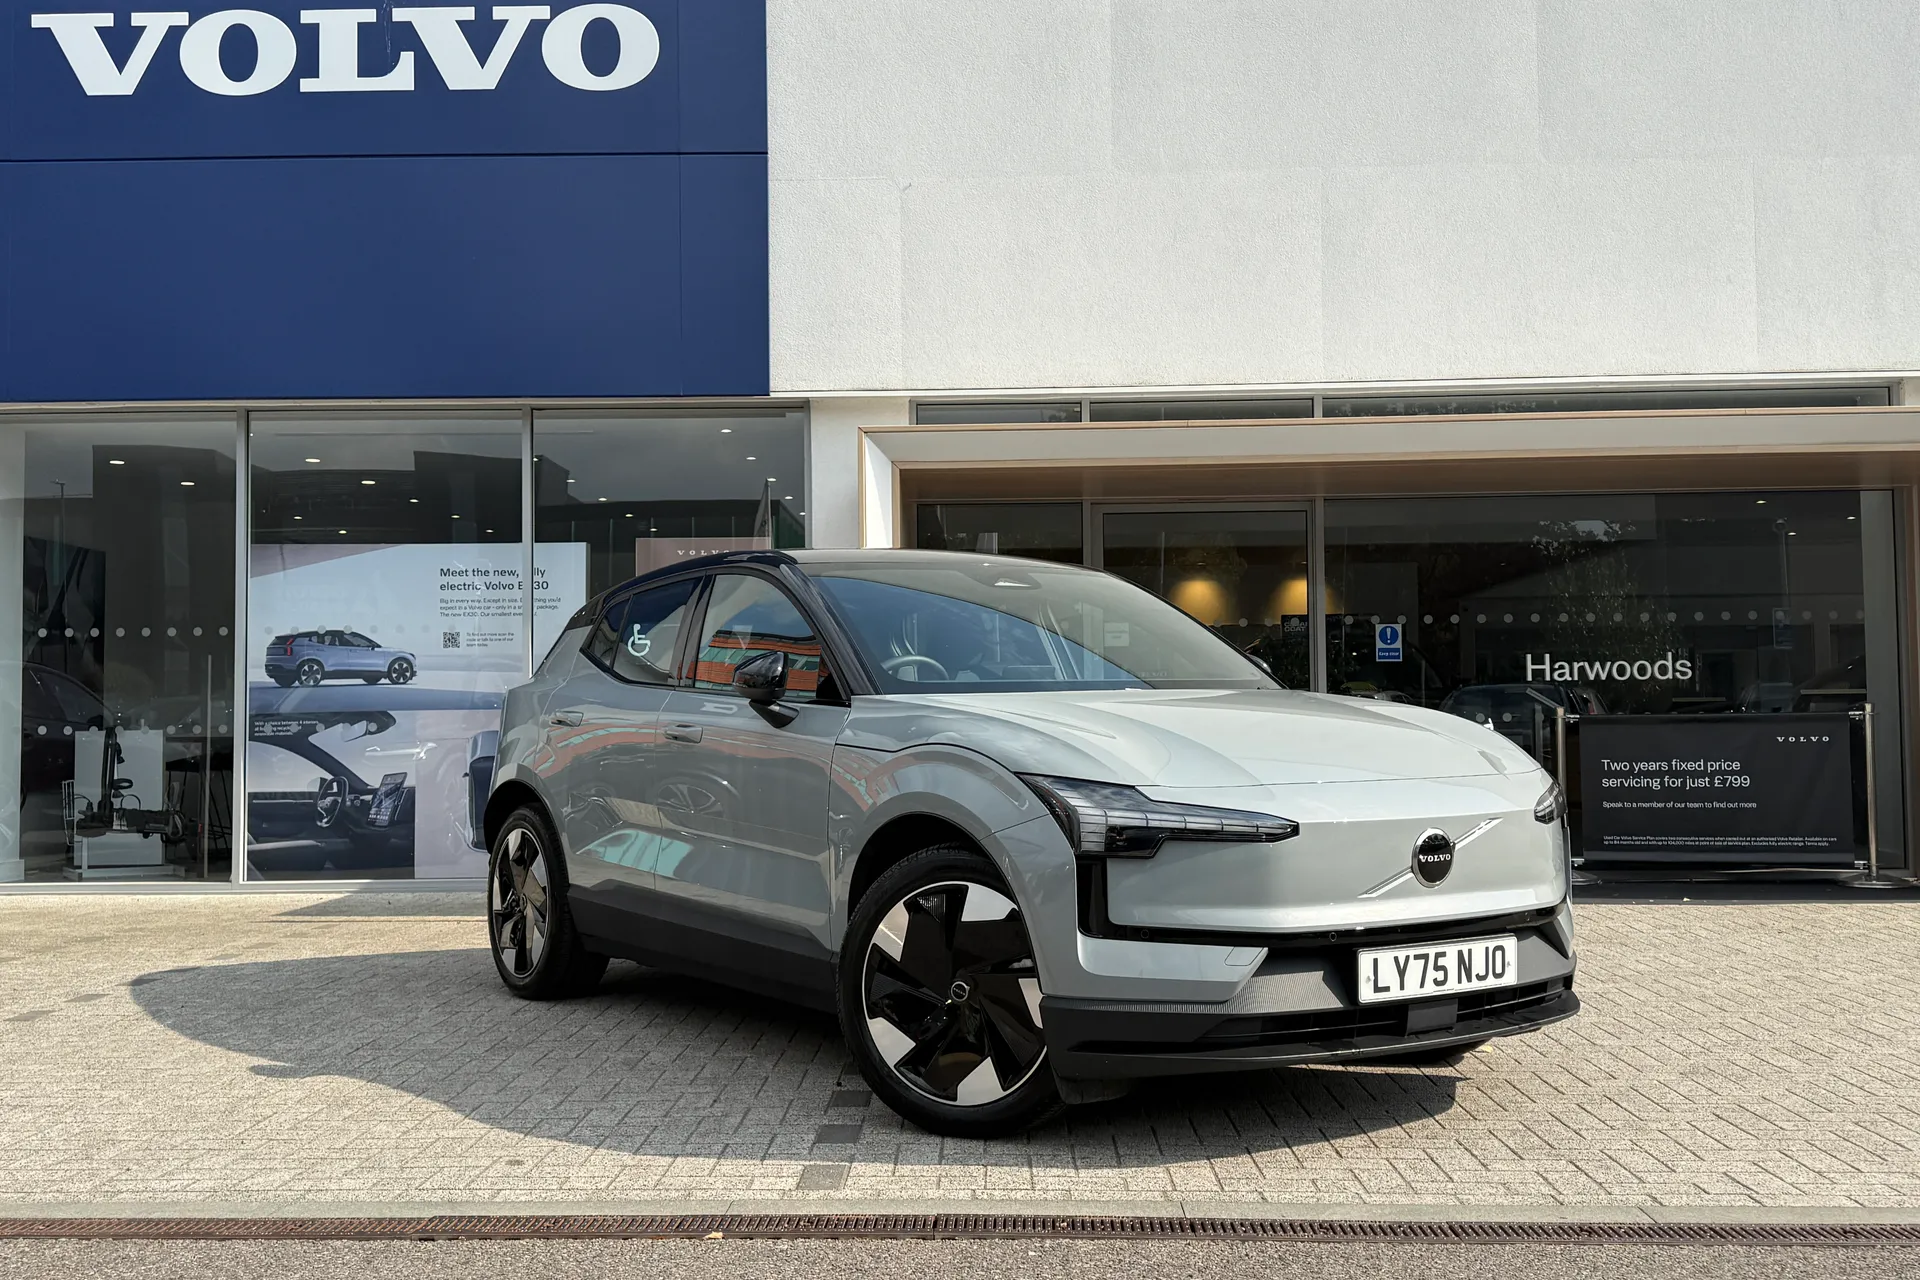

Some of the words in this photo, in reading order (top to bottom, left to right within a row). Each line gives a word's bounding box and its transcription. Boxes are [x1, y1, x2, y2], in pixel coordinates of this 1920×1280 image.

[31, 3, 660, 96] VOLVO
[440, 568, 469, 577] Meet
[472, 568, 490, 577] the
[493, 570, 519, 578] new,
[440, 582, 482, 590] electric
[484, 581, 514, 590] Volvo
[518, 581, 549, 590] E30
[1526, 652, 1692, 682] Harwoods
[1601, 760, 1630, 770] Two
[1632, 761, 1668, 773] years
[1672, 759, 1704, 770] fixed
[1707, 759, 1741, 772] price
[1602, 776, 1661, 790] servicing
[1664, 776, 1684, 787] for
[1686, 776, 1711, 790] just
[1714, 776, 1751, 787] £799
[1419, 854, 1451, 862] VOLVO
[1373, 952, 1448, 994] LY75
[1458, 944, 1506, 984] NJO
